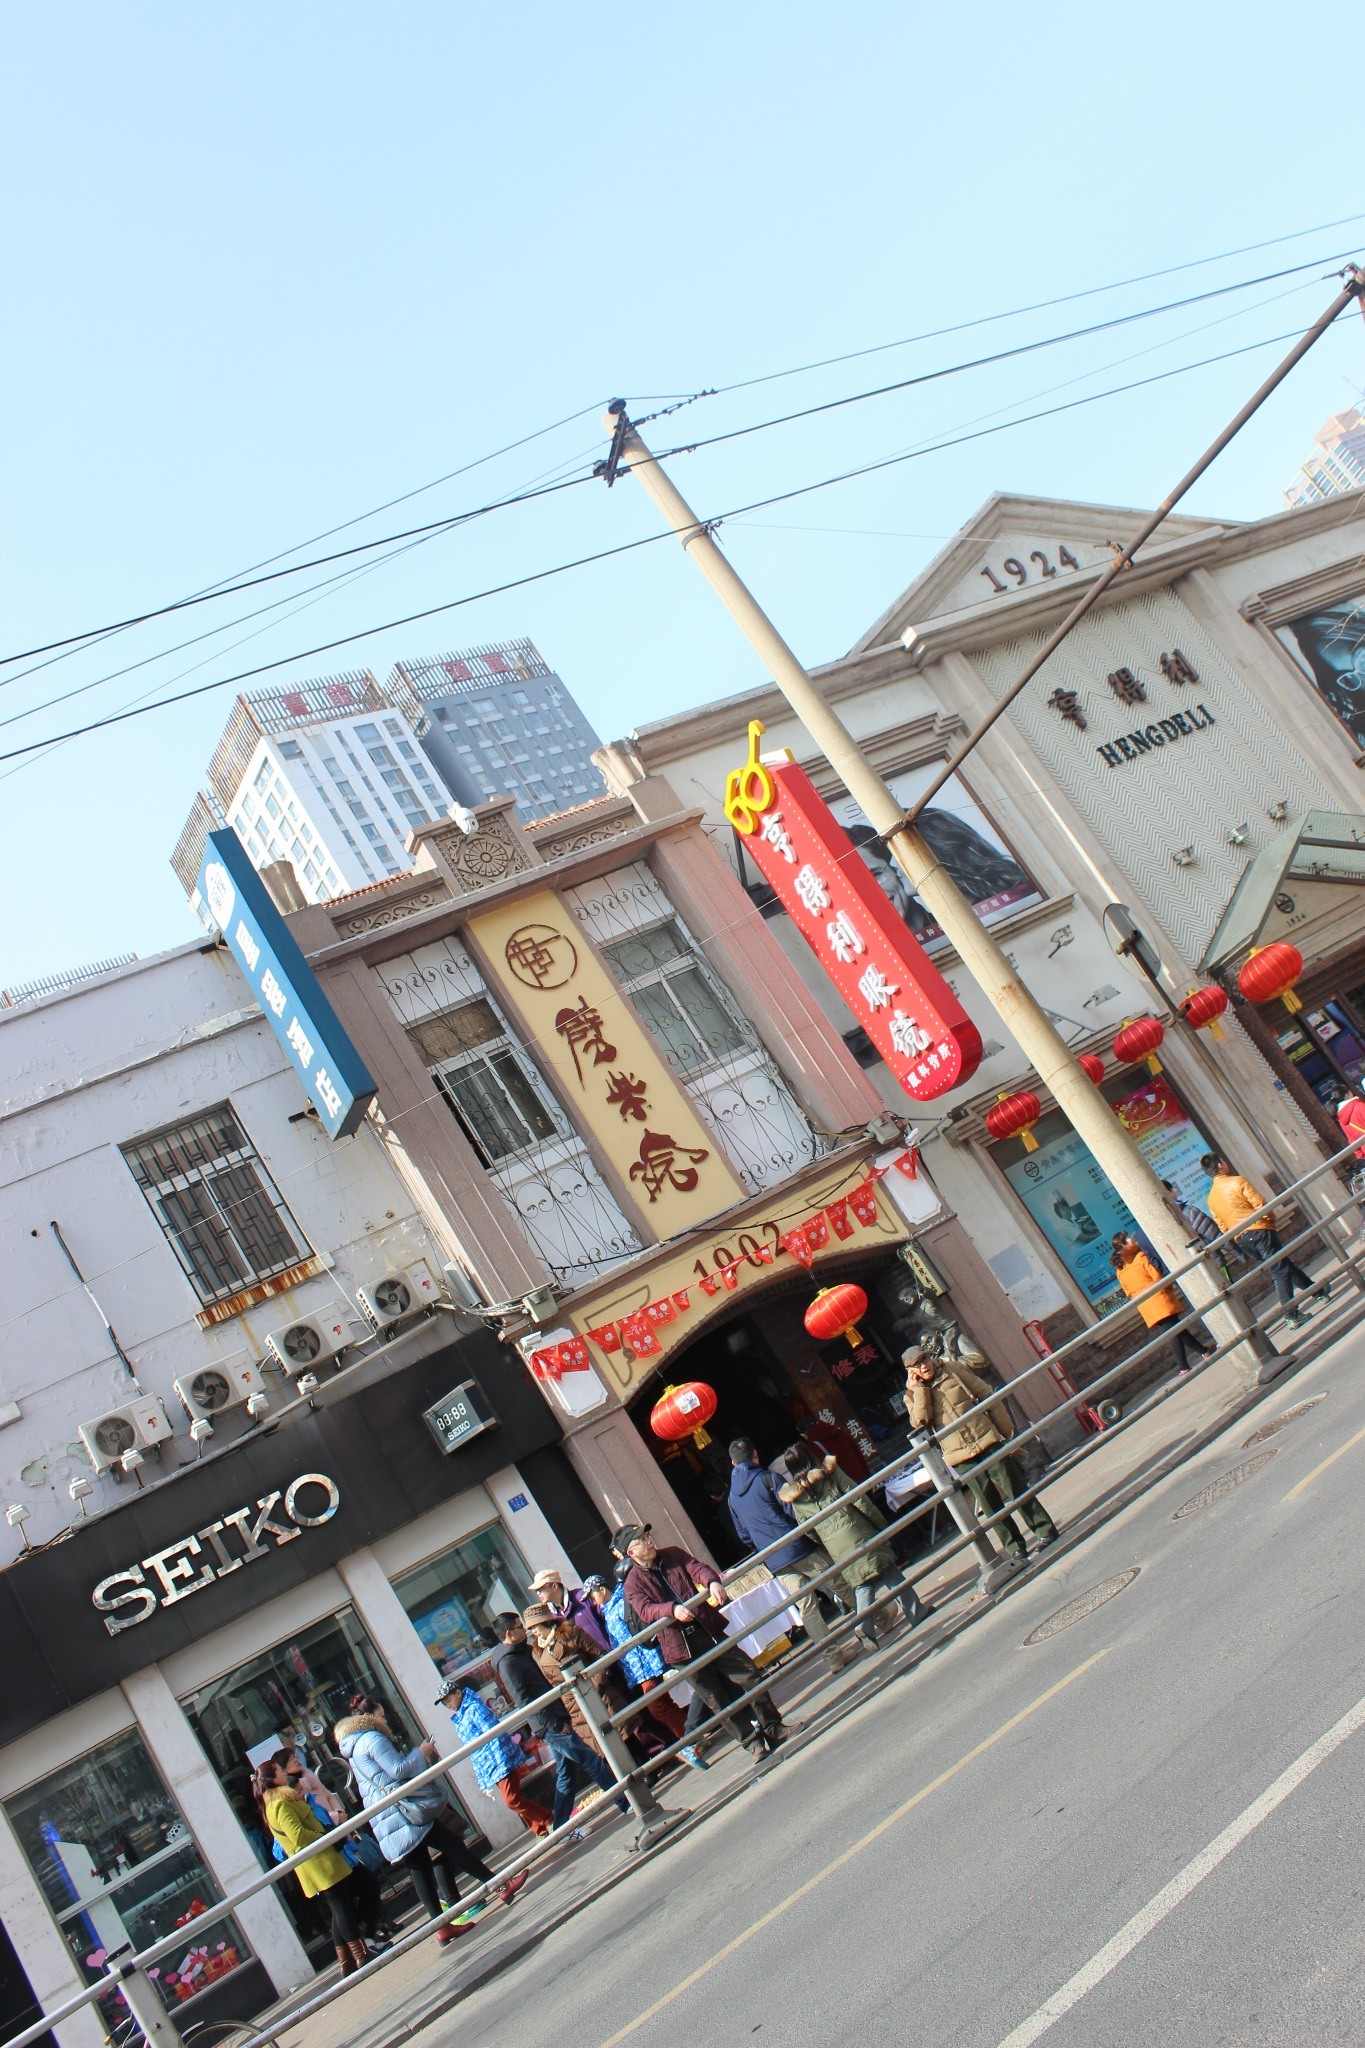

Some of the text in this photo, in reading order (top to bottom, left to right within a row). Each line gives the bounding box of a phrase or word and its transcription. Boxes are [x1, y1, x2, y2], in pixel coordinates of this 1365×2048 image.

[979, 545, 1078, 592] 1924
[1048, 649, 1198, 731] 亨得利
[1097, 703, 1216, 768] HENGDELI
[761, 811, 934, 1059] 亨得利眼镜
[1286, 913, 1306, 927] 1924
[236, 920, 342, 1119] 星程酒店
[906, 1042, 952, 1088] 眼科诊所
[553, 995, 709, 1203] 劈柴院
[692, 1221, 788, 1289] 1902
[831, 1344, 879, 1381] 修表
[447, 1420, 471, 1441] SEIKO
[847, 1419, 876, 1457] 卖表
[92, 1473, 339, 1636] SEIKO
